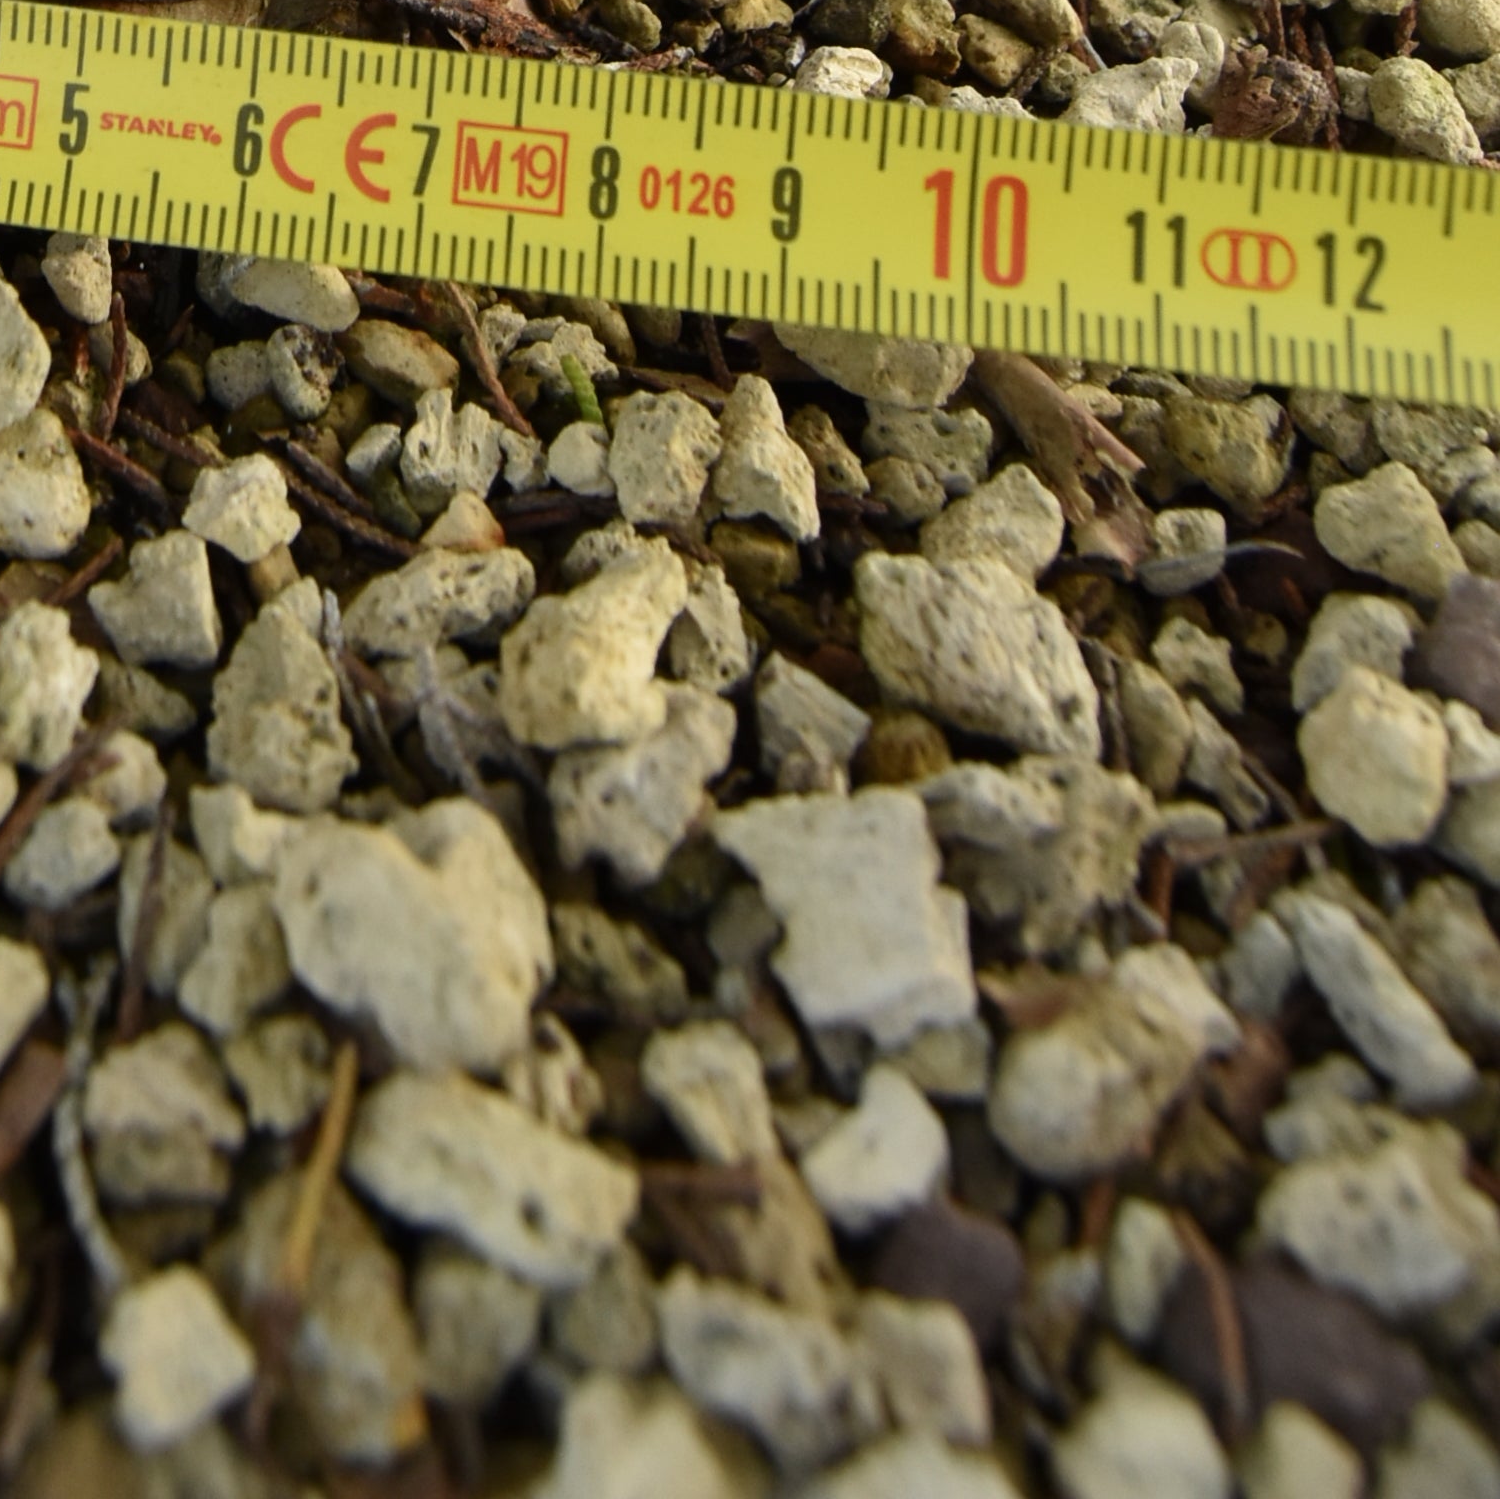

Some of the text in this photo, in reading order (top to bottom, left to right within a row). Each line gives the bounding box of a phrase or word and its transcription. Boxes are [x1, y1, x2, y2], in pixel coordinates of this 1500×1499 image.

[58, 83, 90, 156] 5
[100, 111, 216, 144] STANLEY
[232, 104, 264, 177] 6
[269, 104, 397, 202] CE
[411, 124, 441, 196] 7
[588, 145, 621, 220] 8
[639, 165, 736, 219] 0126
[771, 166, 803, 243] 9
[924, 169, 1029, 287] 10
[1126, 210, 1186, 288] 11
[1315, 231, 1387, 312] 12
